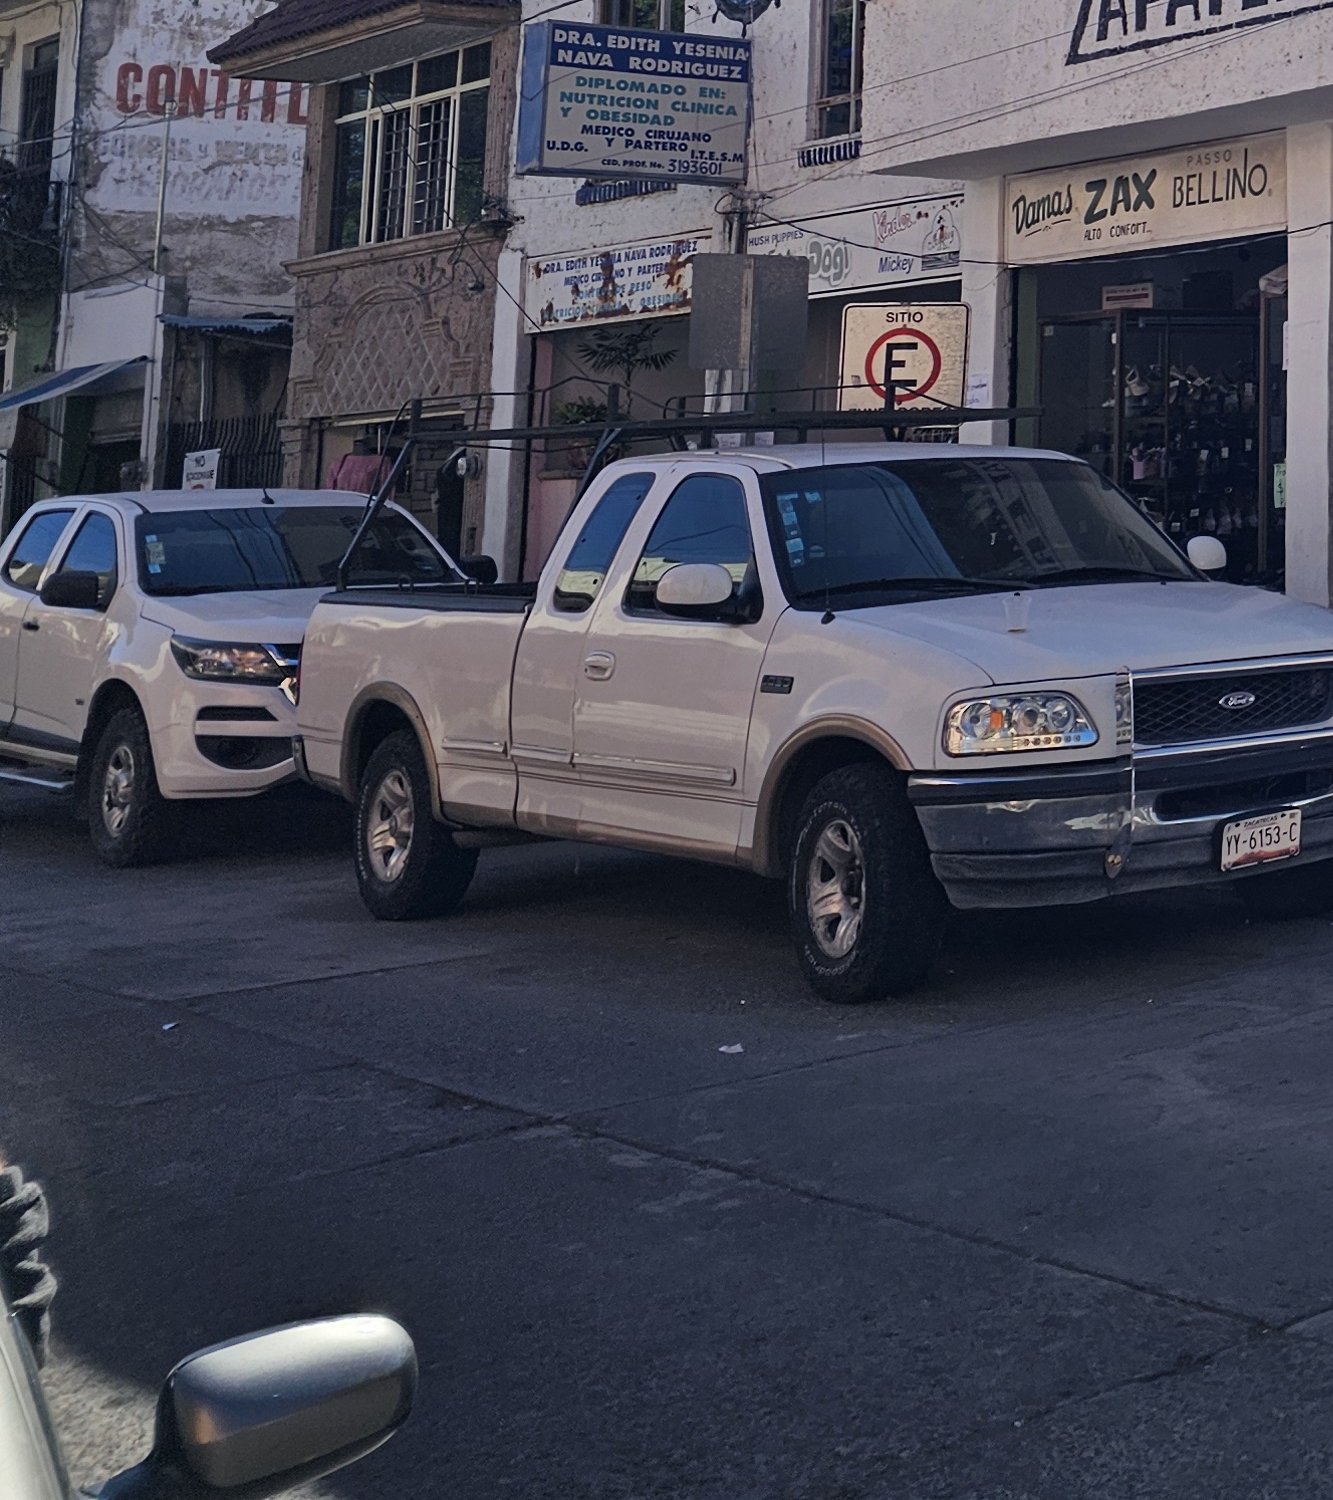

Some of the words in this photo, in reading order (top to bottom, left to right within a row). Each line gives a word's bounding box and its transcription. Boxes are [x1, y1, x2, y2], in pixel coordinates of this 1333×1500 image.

[554, 29, 602, 47] DRA.
[607, 34, 660, 53] EDITH
[672, 41, 748, 61] YESENIA
[557, 49, 613, 67] NAVA
[628, 56, 742, 79] RODRIGUEZ
[575, 76, 687, 96] DIPLOMADO
[698, 86, 726, 99] EN:
[559, 91, 659, 110] NUTRICION
[670, 100, 737, 117] CLINICA
[559, 106, 572, 118] Y
[586, 108, 675, 126] OBESIDAD
[580, 124, 635, 138] MEDICO
[645, 129, 712, 143] CIRUJANO
[546, 140, 589, 152] U.D.G.
[605, 137, 615, 148] Y
[625, 139, 688, 152] PARTERO
[668, 159, 722, 175] 3193601
[1186, 149, 1232, 168] PASSO
[1084, 168, 1157, 225] ZAX
[1012, 184, 1072, 235] Damas
[748, 235, 770, 247] HUSH
[772, 229, 804, 244] PUPPIES
[1084, 228, 1102, 241] ALTO
[544, 261, 564, 274] DRA.
[566, 258, 588, 270] EDITH
[624, 249, 647, 262] NAVA
[878, 255, 915, 274] Mickey
[563, 273, 589, 287] MEDICO
[628, 267, 633, 277] Y
[630, 280, 653, 295] PESO
[886, 311, 923, 323] SITIO
[1243, 815, 1278, 828] ZACATECAS
[1226, 822, 1297, 856] YY-6153-C
